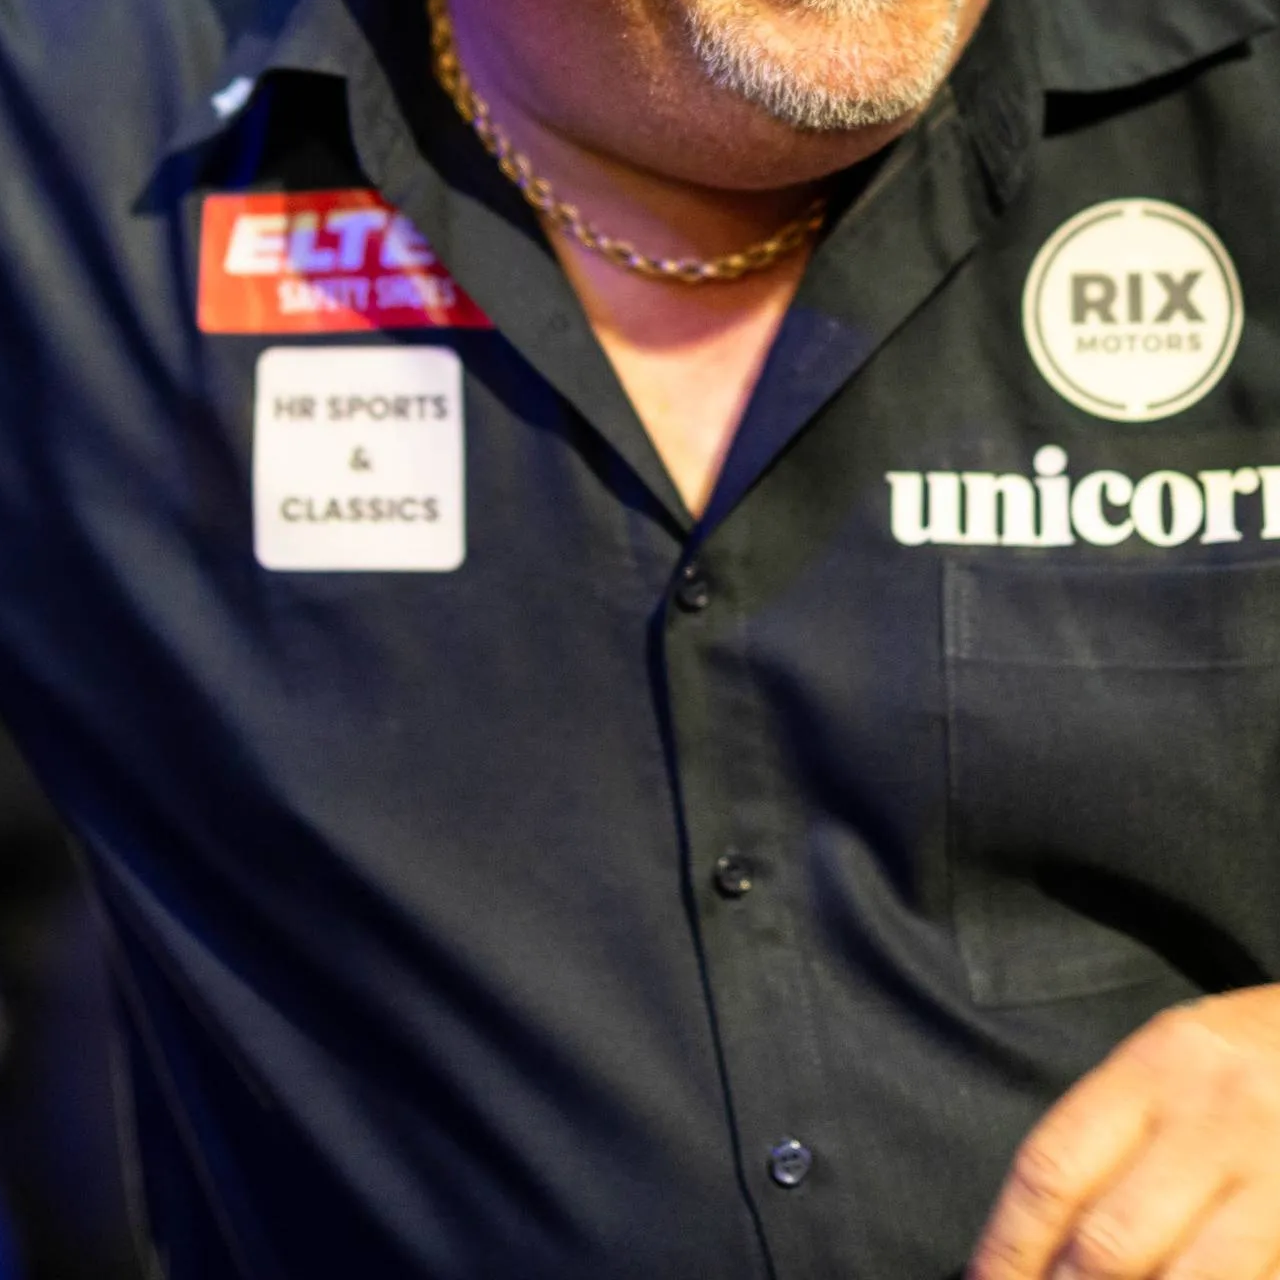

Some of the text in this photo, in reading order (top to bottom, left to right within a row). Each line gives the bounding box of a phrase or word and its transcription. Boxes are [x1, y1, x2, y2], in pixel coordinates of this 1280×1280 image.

[1069, 269, 1206, 326] RIX
[1074, 333, 1203, 354] MOTORS
[273, 394, 448, 420] HR SPORTS
[349, 445, 373, 472] &
[280, 496, 440, 523] CLASSICS
